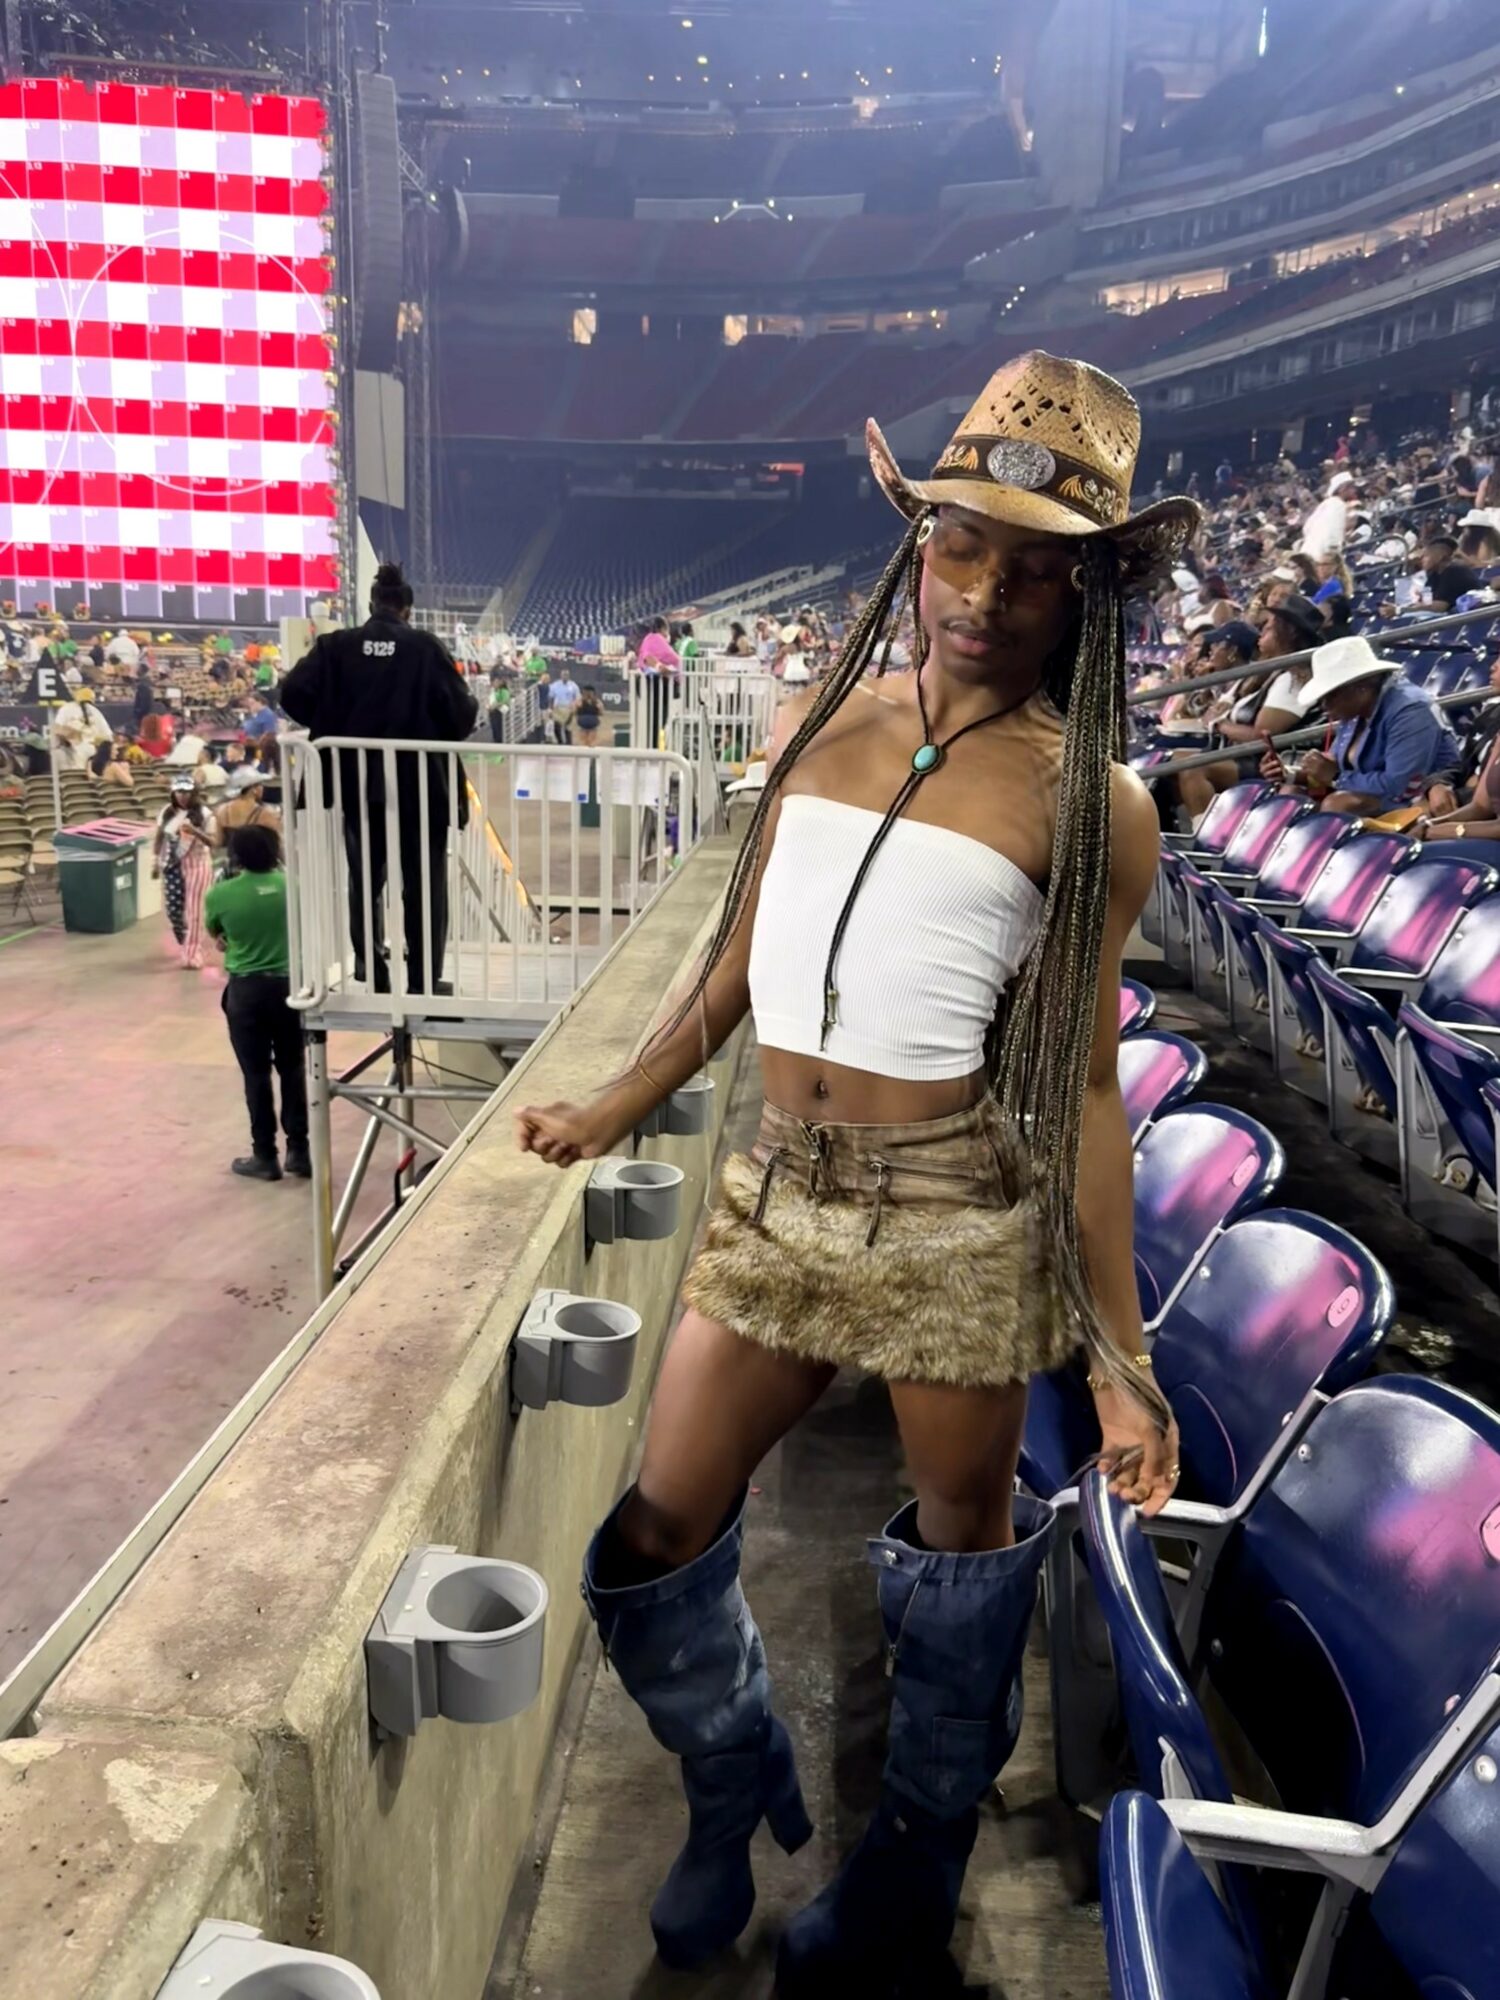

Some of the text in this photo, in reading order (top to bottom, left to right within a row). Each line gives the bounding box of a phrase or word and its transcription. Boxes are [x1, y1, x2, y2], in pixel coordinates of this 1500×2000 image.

[363, 640, 396, 656] 5125
[38, 667, 57, 697] E
[602, 692, 621, 705] nrg
